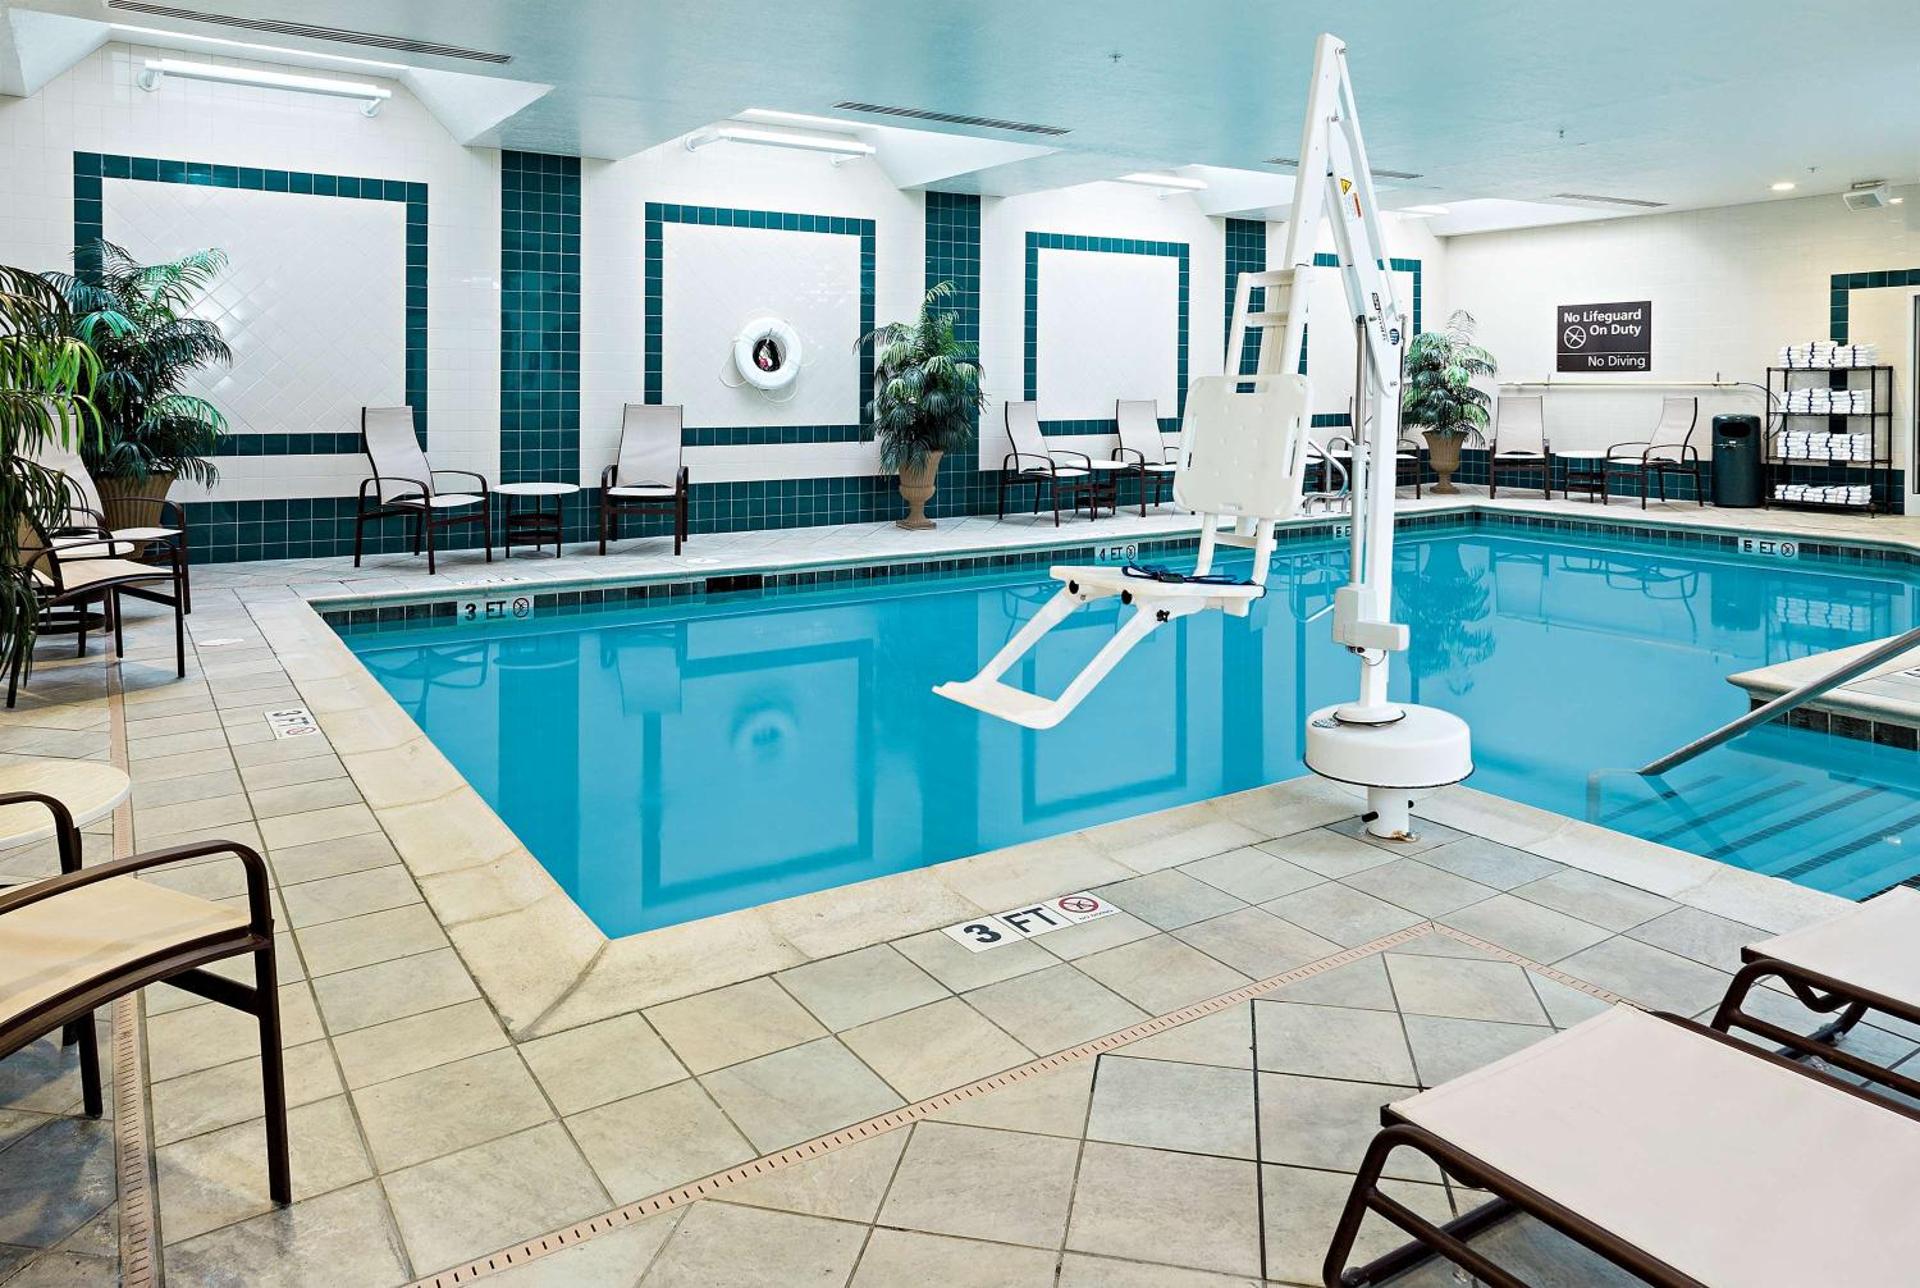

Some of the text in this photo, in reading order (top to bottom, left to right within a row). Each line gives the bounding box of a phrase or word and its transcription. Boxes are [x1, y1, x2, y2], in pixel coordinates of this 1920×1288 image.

[1563, 308, 1642, 324] No Lifeguard
[1589, 323, 1641, 337] On Duty
[1587, 355, 1646, 369] No Diving
[465, 602, 477, 619] 3
[963, 923, 1002, 943] 3
[1002, 907, 1058, 933] FT
